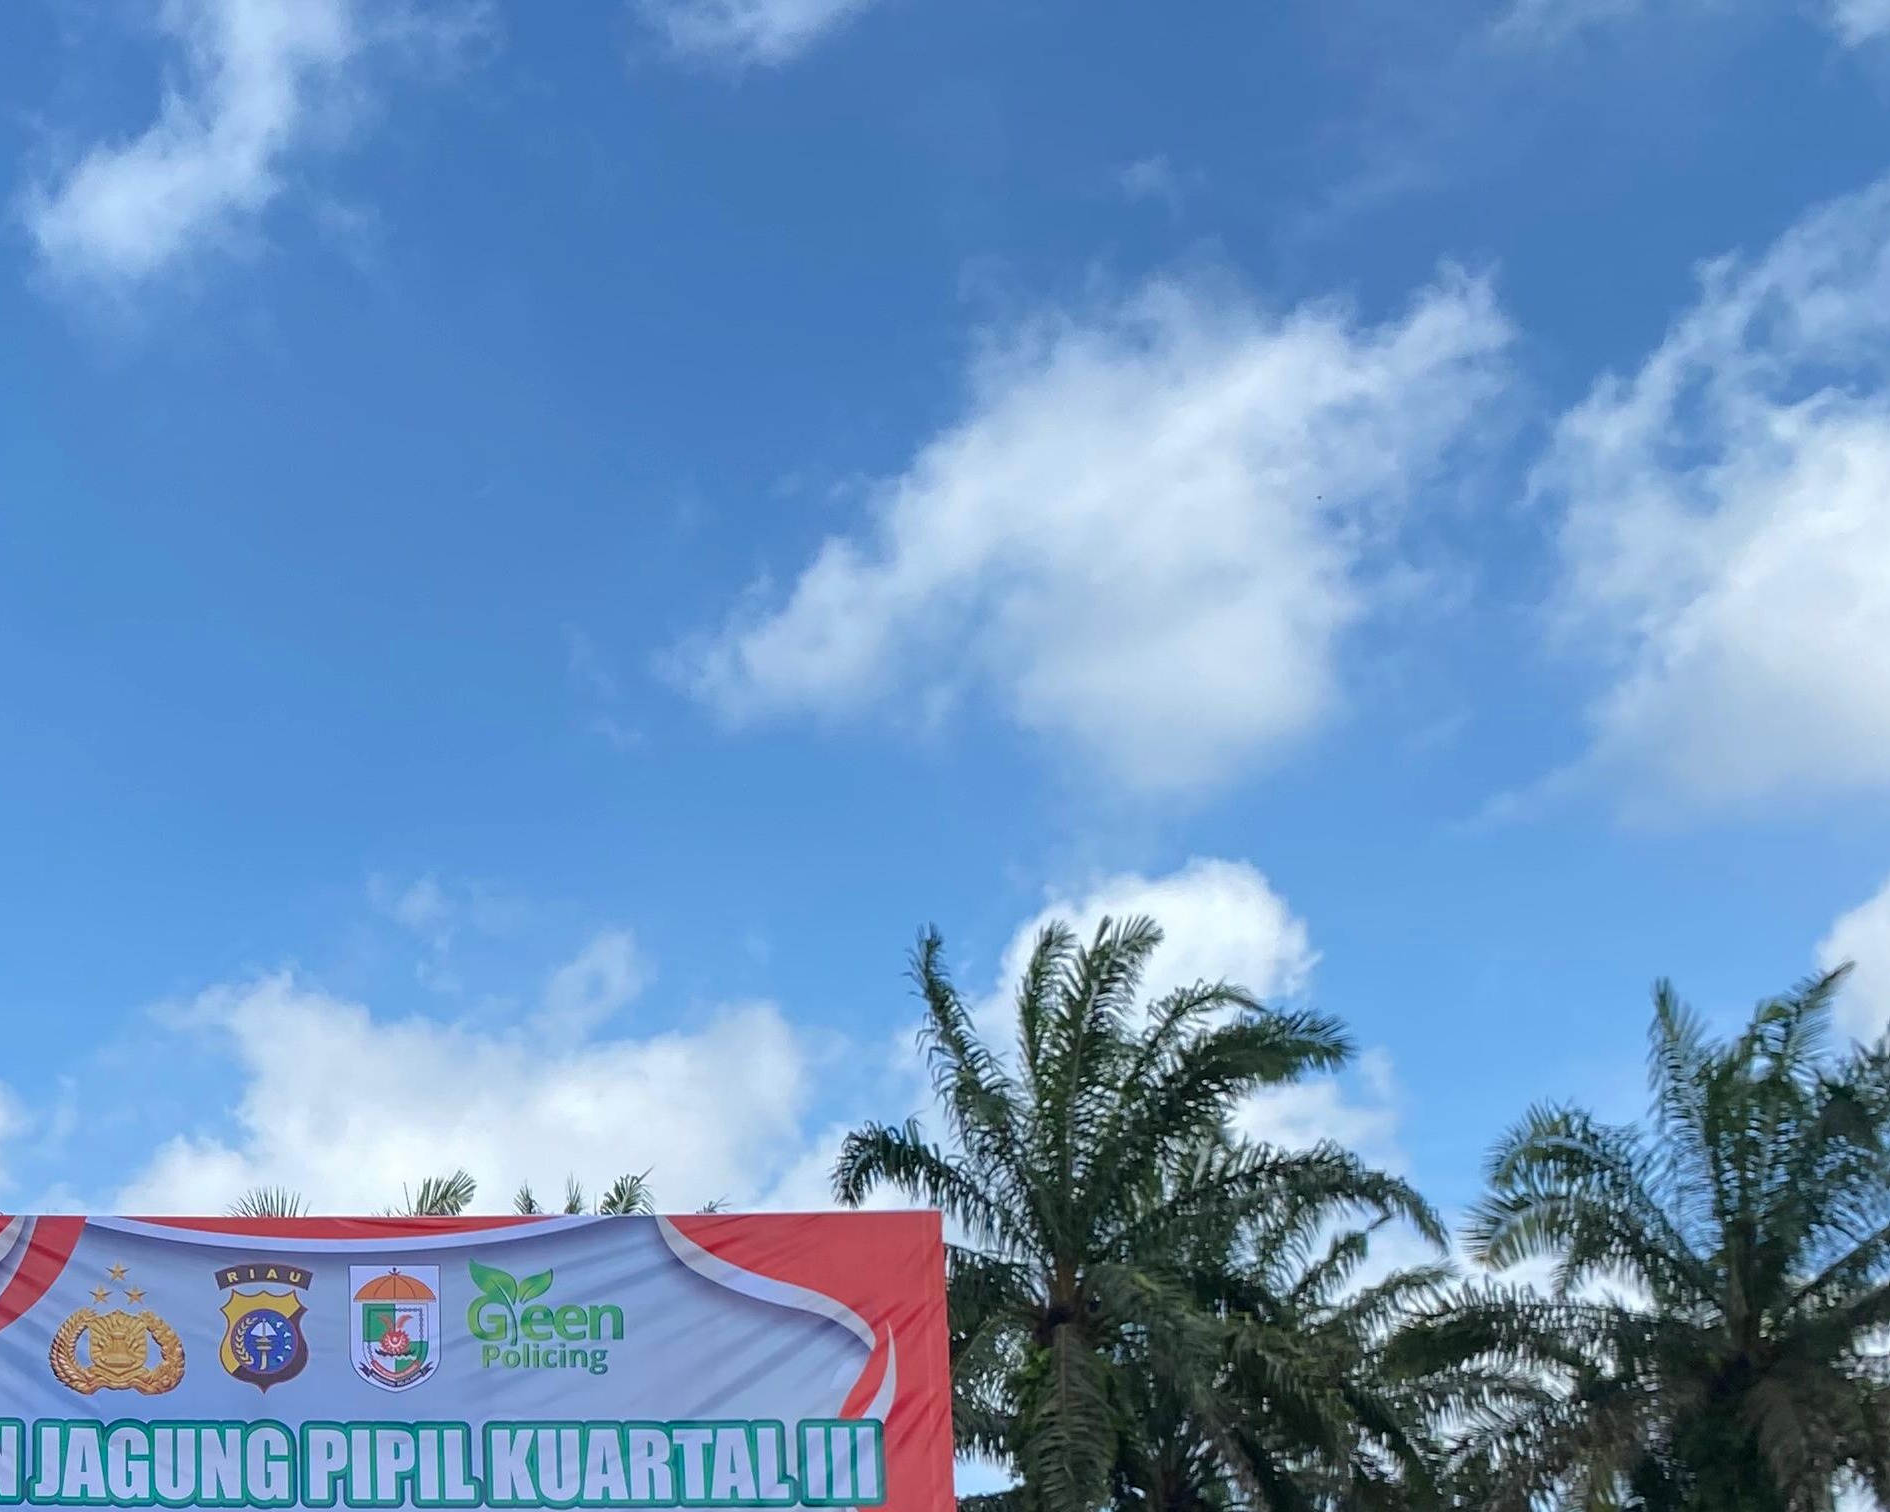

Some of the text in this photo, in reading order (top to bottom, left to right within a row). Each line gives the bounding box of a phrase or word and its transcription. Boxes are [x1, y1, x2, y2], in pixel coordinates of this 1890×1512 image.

[225, 1266, 301, 1285] RIAU
[480, 1341, 610, 1376] Policing
[32, 1424, 291, 1501] JAGUNG
[307, 1426, 477, 1501] PIPIL
[490, 1426, 791, 1501] KUARTAL
[803, 1425, 880, 1500] III
